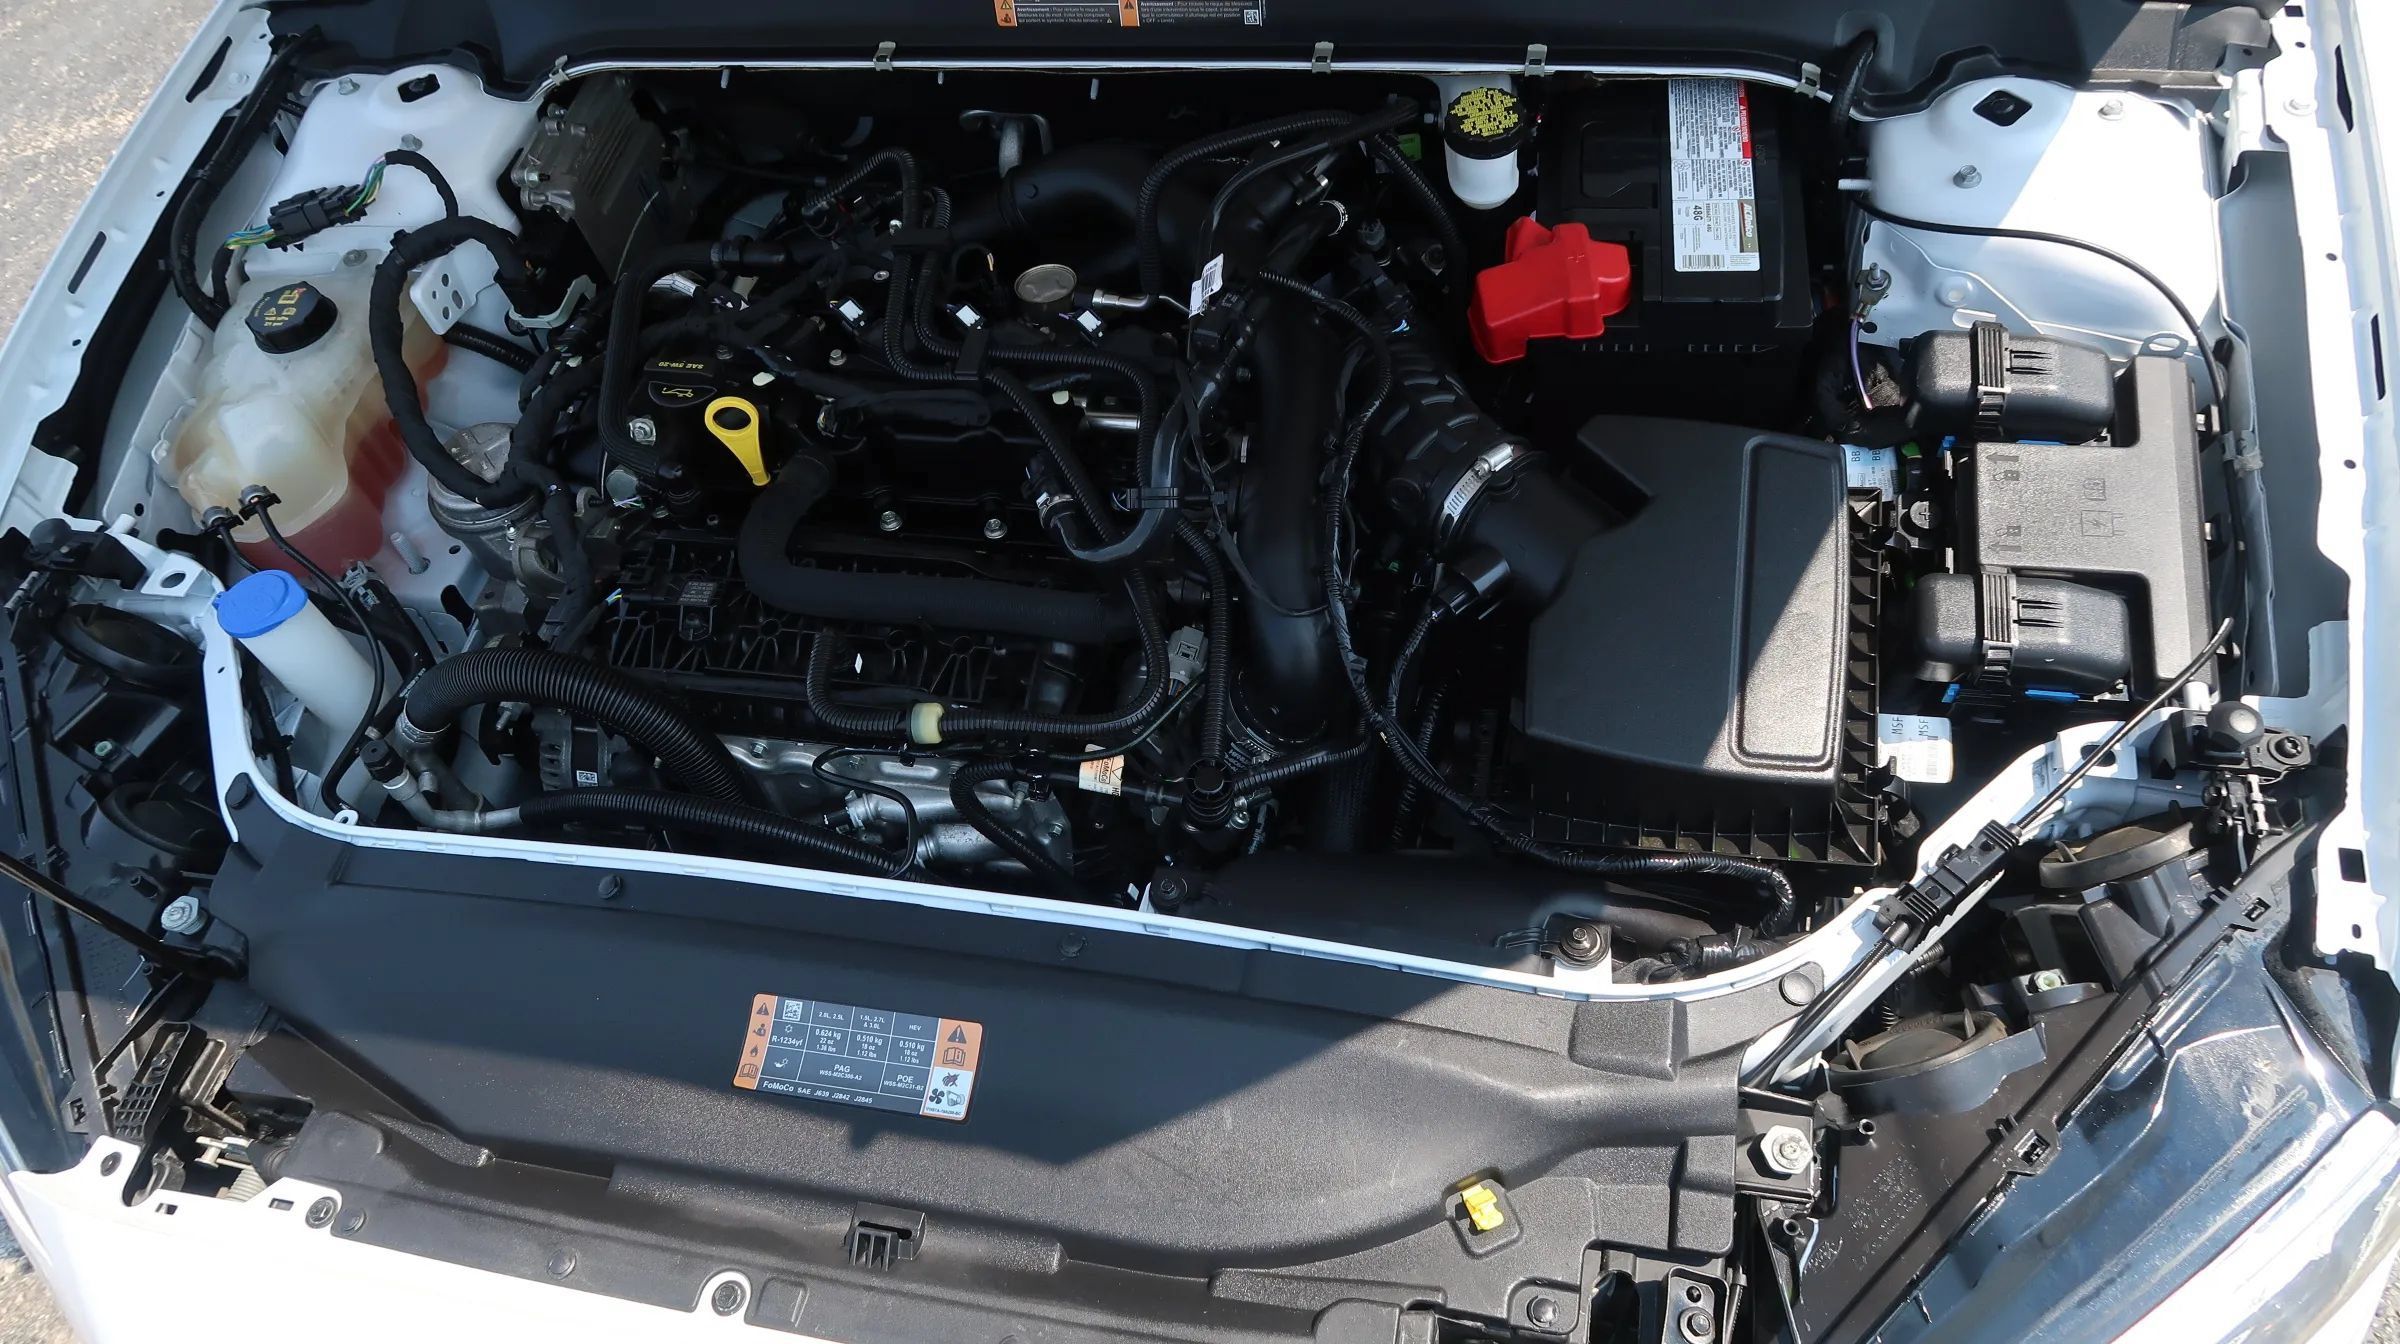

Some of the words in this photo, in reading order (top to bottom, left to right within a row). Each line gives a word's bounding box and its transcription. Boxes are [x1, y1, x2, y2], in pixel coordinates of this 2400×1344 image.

[1693, 205, 1703, 221] 48G
[1744, 204, 1753, 237] ACDelco
[1892, 716, 1903, 735] MSF
[1918, 719, 1928, 736] MSF
[772, 1035, 803, 1046] R-1234yf
[815, 1029, 832, 1037] 0.624
[833, 1031, 842, 1040] kg
[856, 1034, 873, 1042] 0.510
[874, 1037, 883, 1045] kg
[899, 1040, 916, 1049] 0.510
[917, 1043, 925, 1051] kg
[897, 1074, 914, 1083] POE
[763, 1080, 794, 1092] FoMoCo
[832, 1092, 850, 1101] J2842
[854, 1095, 872, 1104] J2845
